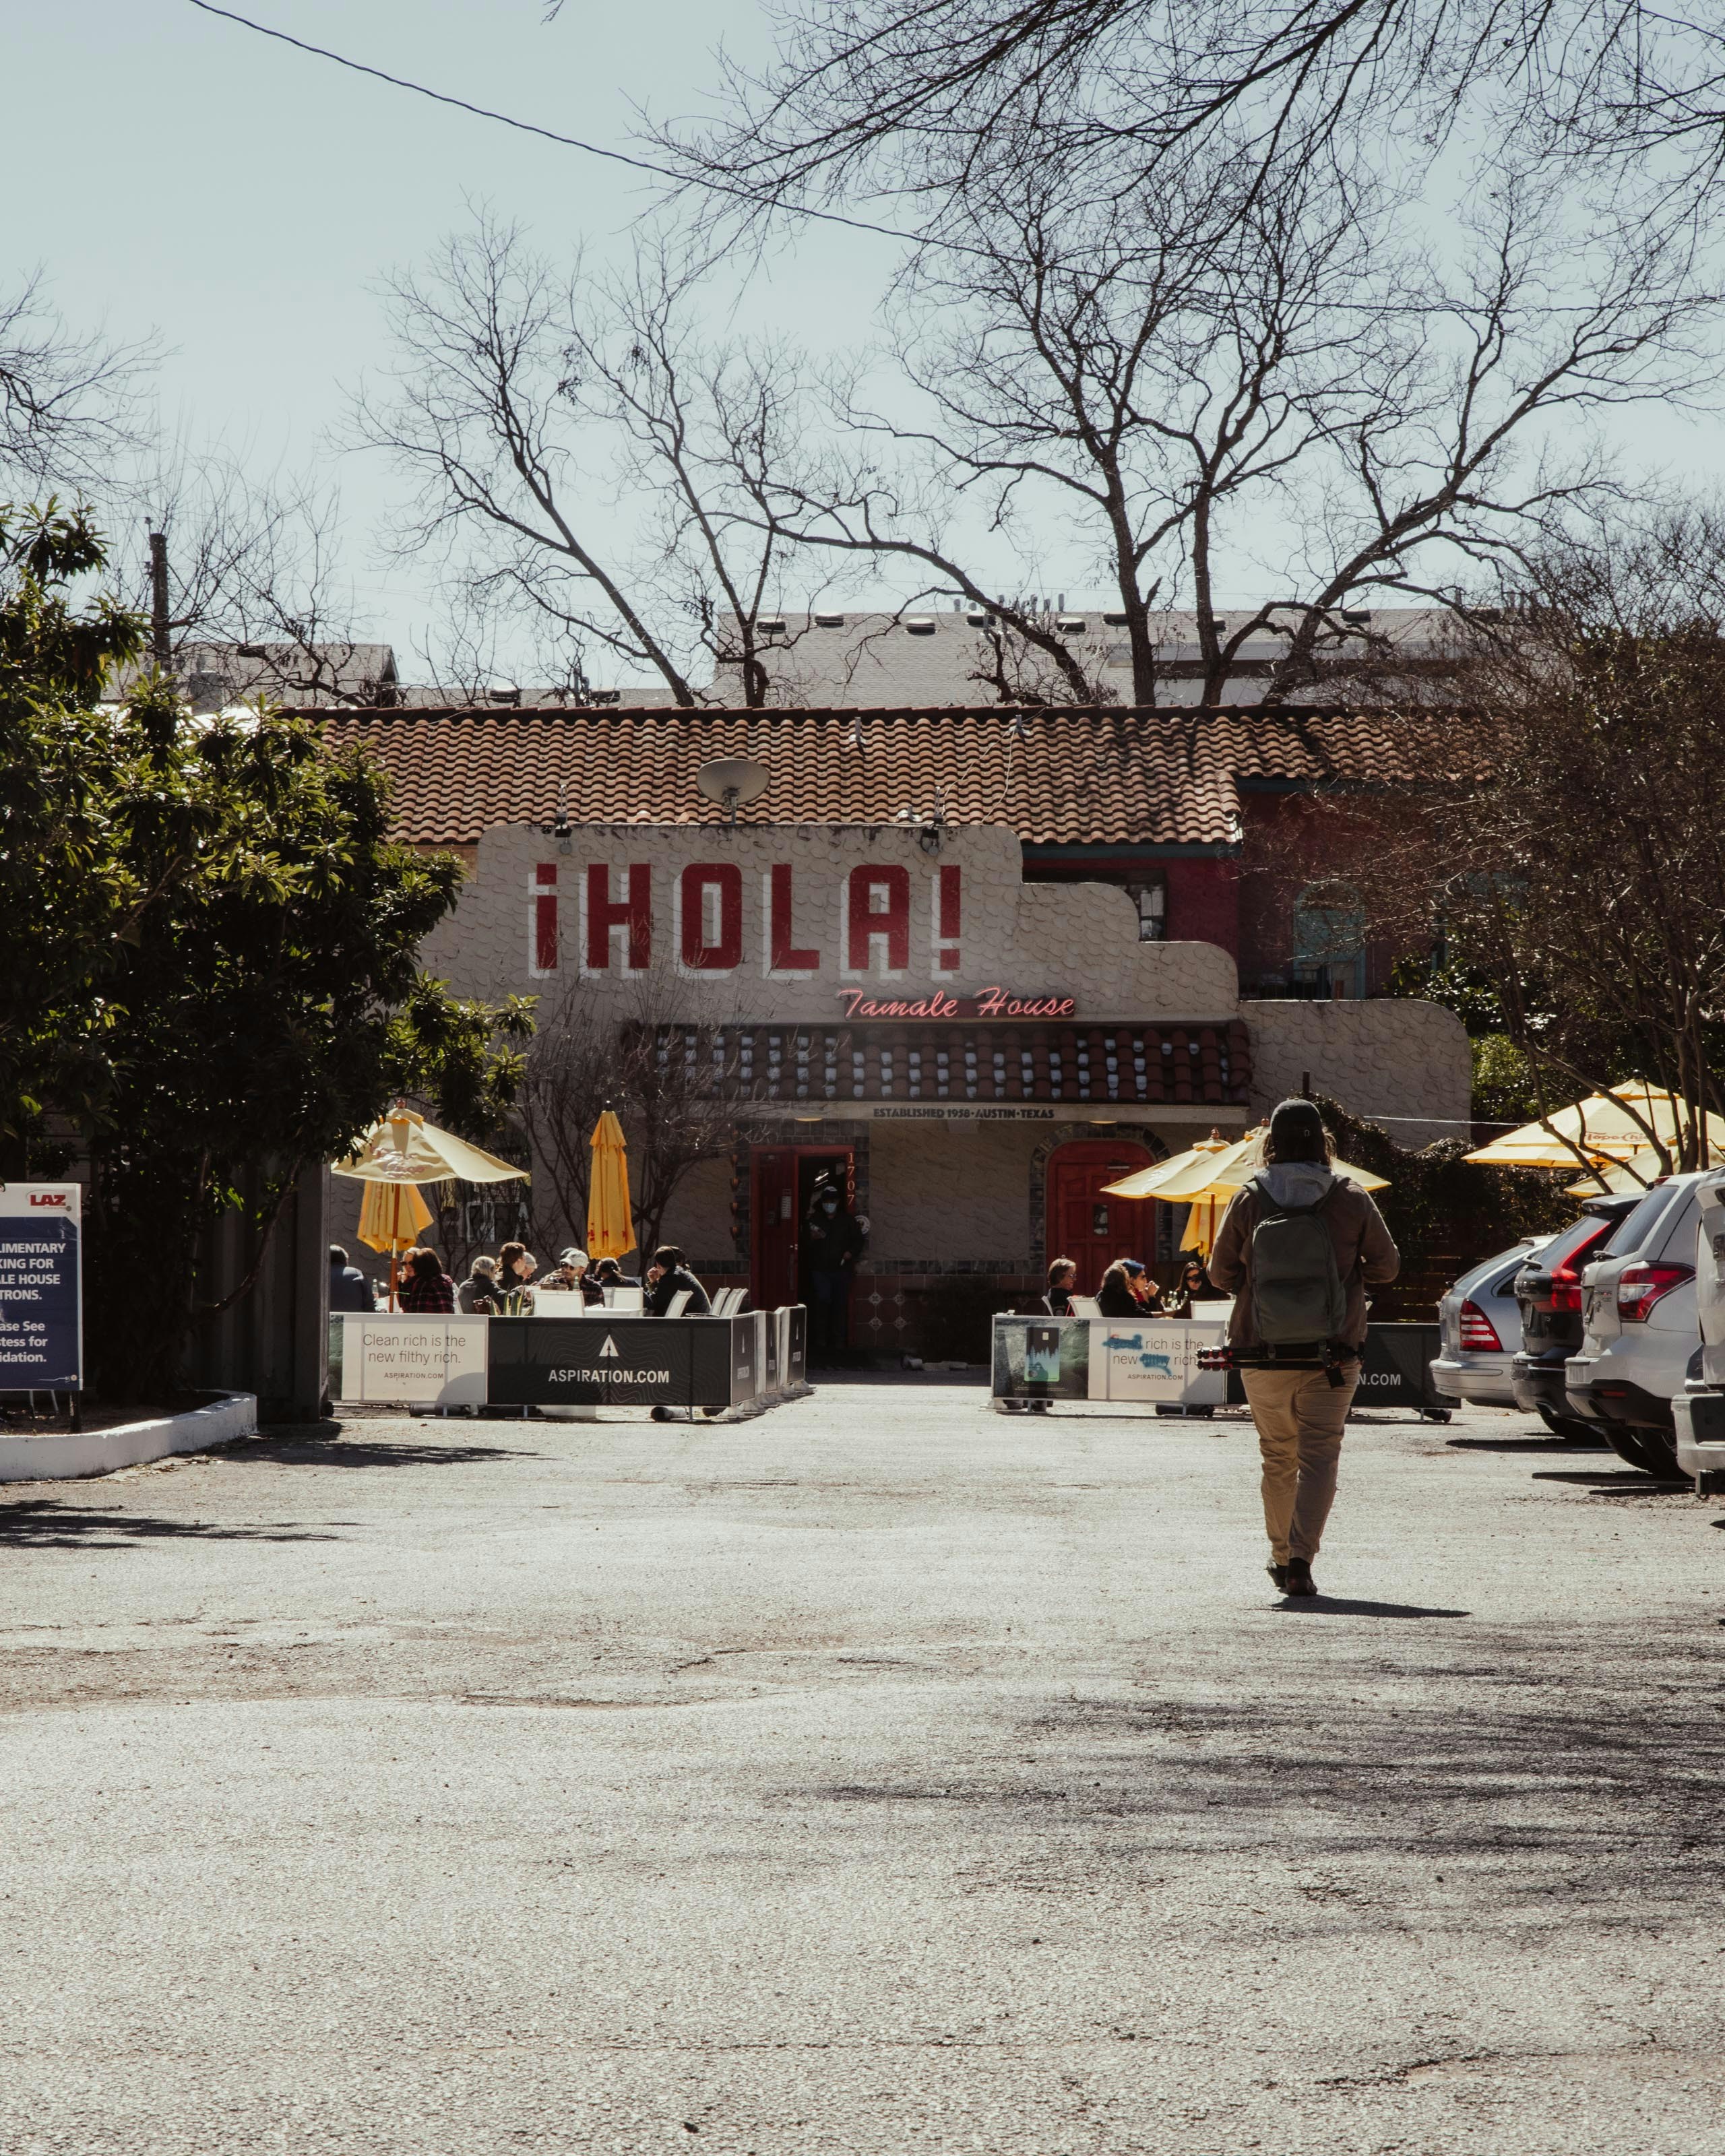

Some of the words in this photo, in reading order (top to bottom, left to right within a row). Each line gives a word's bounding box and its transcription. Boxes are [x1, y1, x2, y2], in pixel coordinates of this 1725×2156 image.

[837, 988, 958, 1017] Tamale
[976, 986, 1074, 1016] House
[873, 1108, 945, 1118] ESTABLISHED
[30, 1195, 66, 1206] LAZ
[29, 1259, 54, 1269] FOR
[19, 1274, 61, 1284] HOUSE
[23, 1321, 45, 1331] See
[0, 1337, 26, 1347] tess
[28, 1336, 48, 1347] for
[363, 1334, 400, 1346] Clean
[404, 1335, 427, 1346] rich
[432, 1335, 441, 1347] is
[445, 1335, 466, 1347] the
[1146, 1338, 1167, 1350] rich
[1172, 1339, 1181, 1350] is
[1186, 1339, 1203, 1350] the
[369, 1353, 395, 1362] new
[399, 1351, 430, 1365] filthy
[435, 1352, 461, 1363] rich.
[1113, 1355, 1137, 1364] new
[548, 1370, 669, 1383] ASPIRATION.COM
